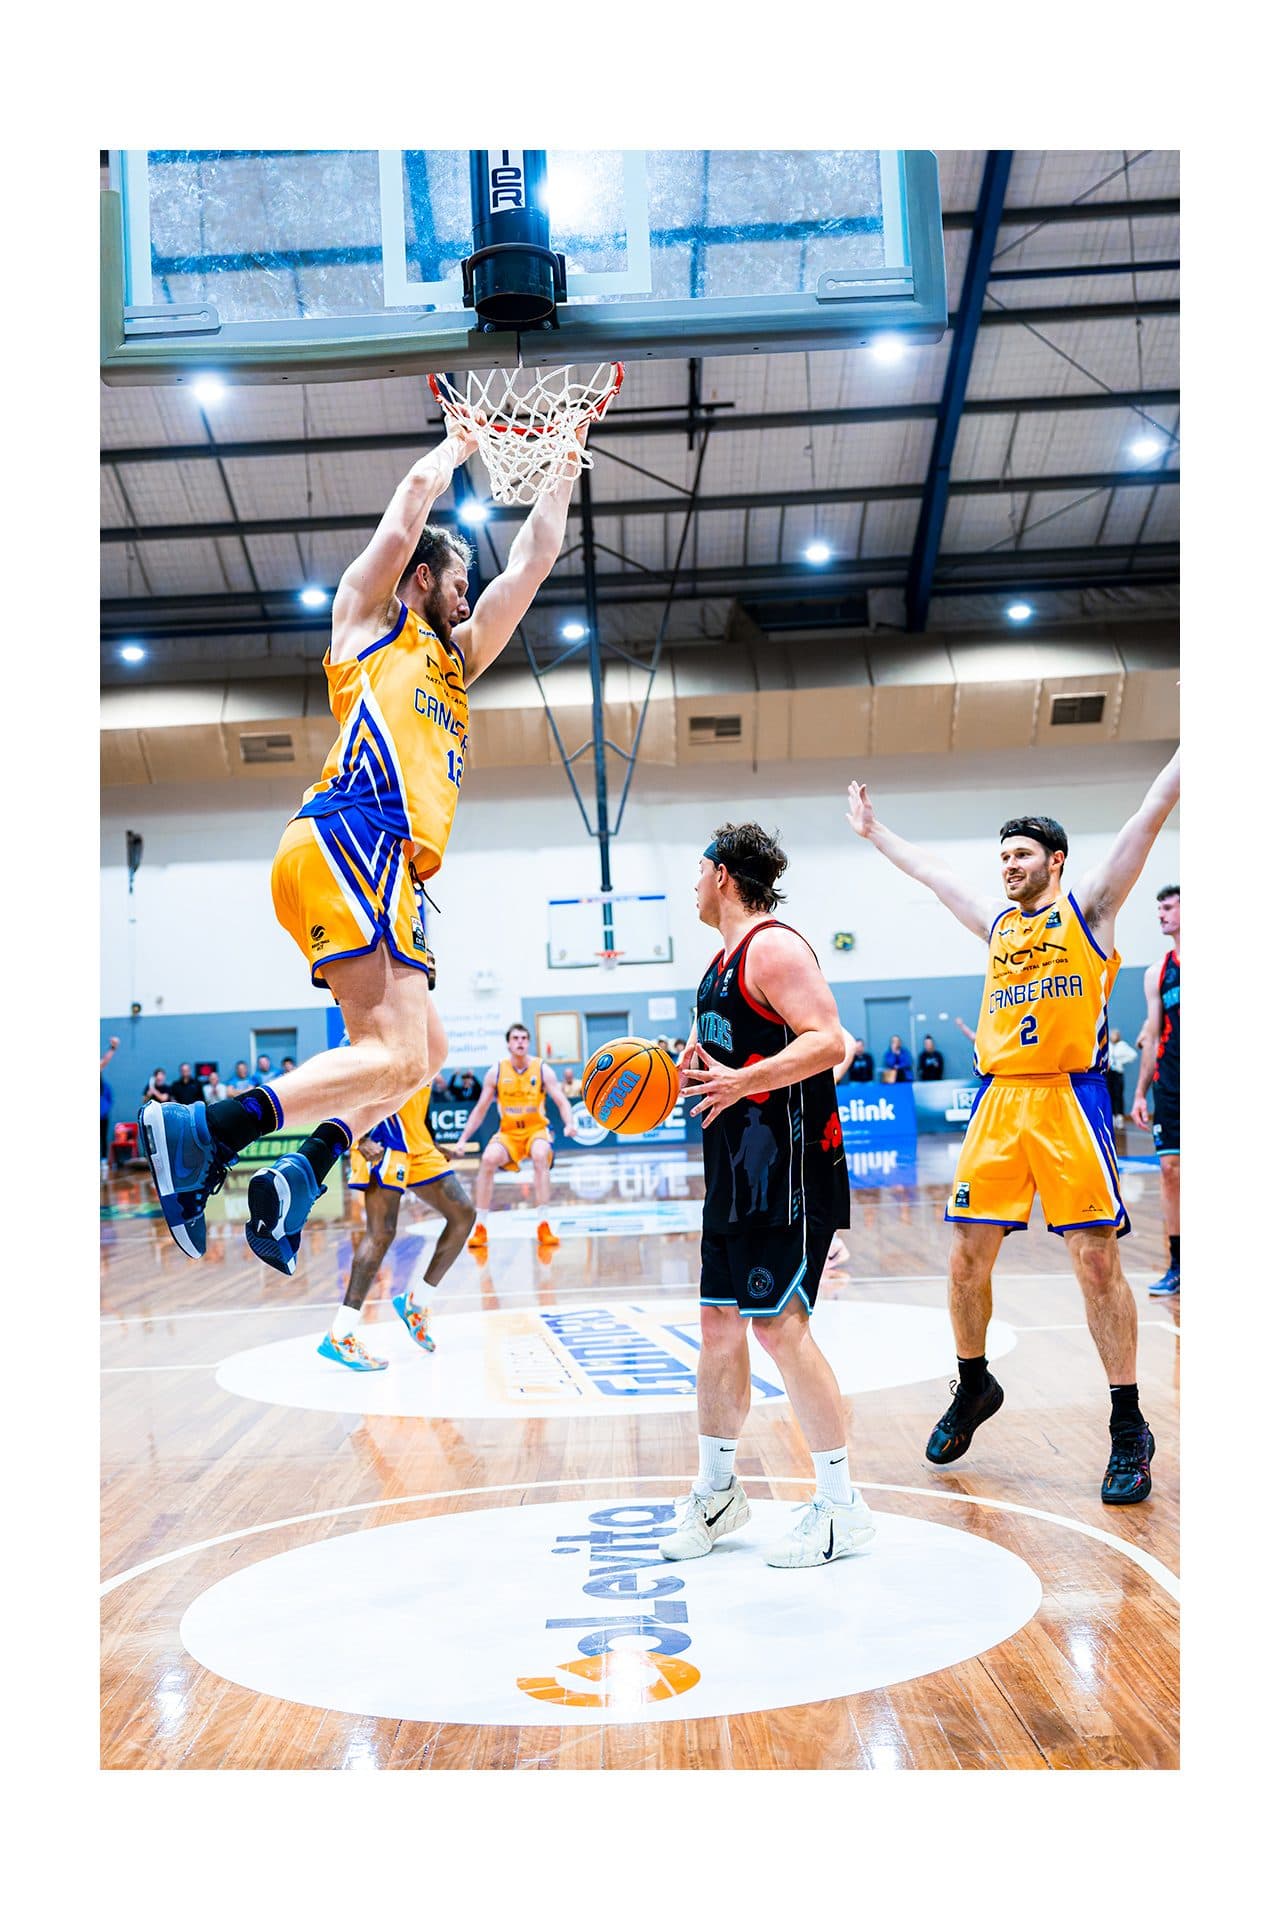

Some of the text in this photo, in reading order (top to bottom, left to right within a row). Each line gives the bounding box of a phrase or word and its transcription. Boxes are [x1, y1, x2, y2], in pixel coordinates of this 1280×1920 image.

[989, 974, 1083, 1014] CANBERRA
[1020, 1014, 1038, 1046] 2
[598, 1070, 641, 1122] Wilson
[540, 1309, 697, 1396] GUNNERS
